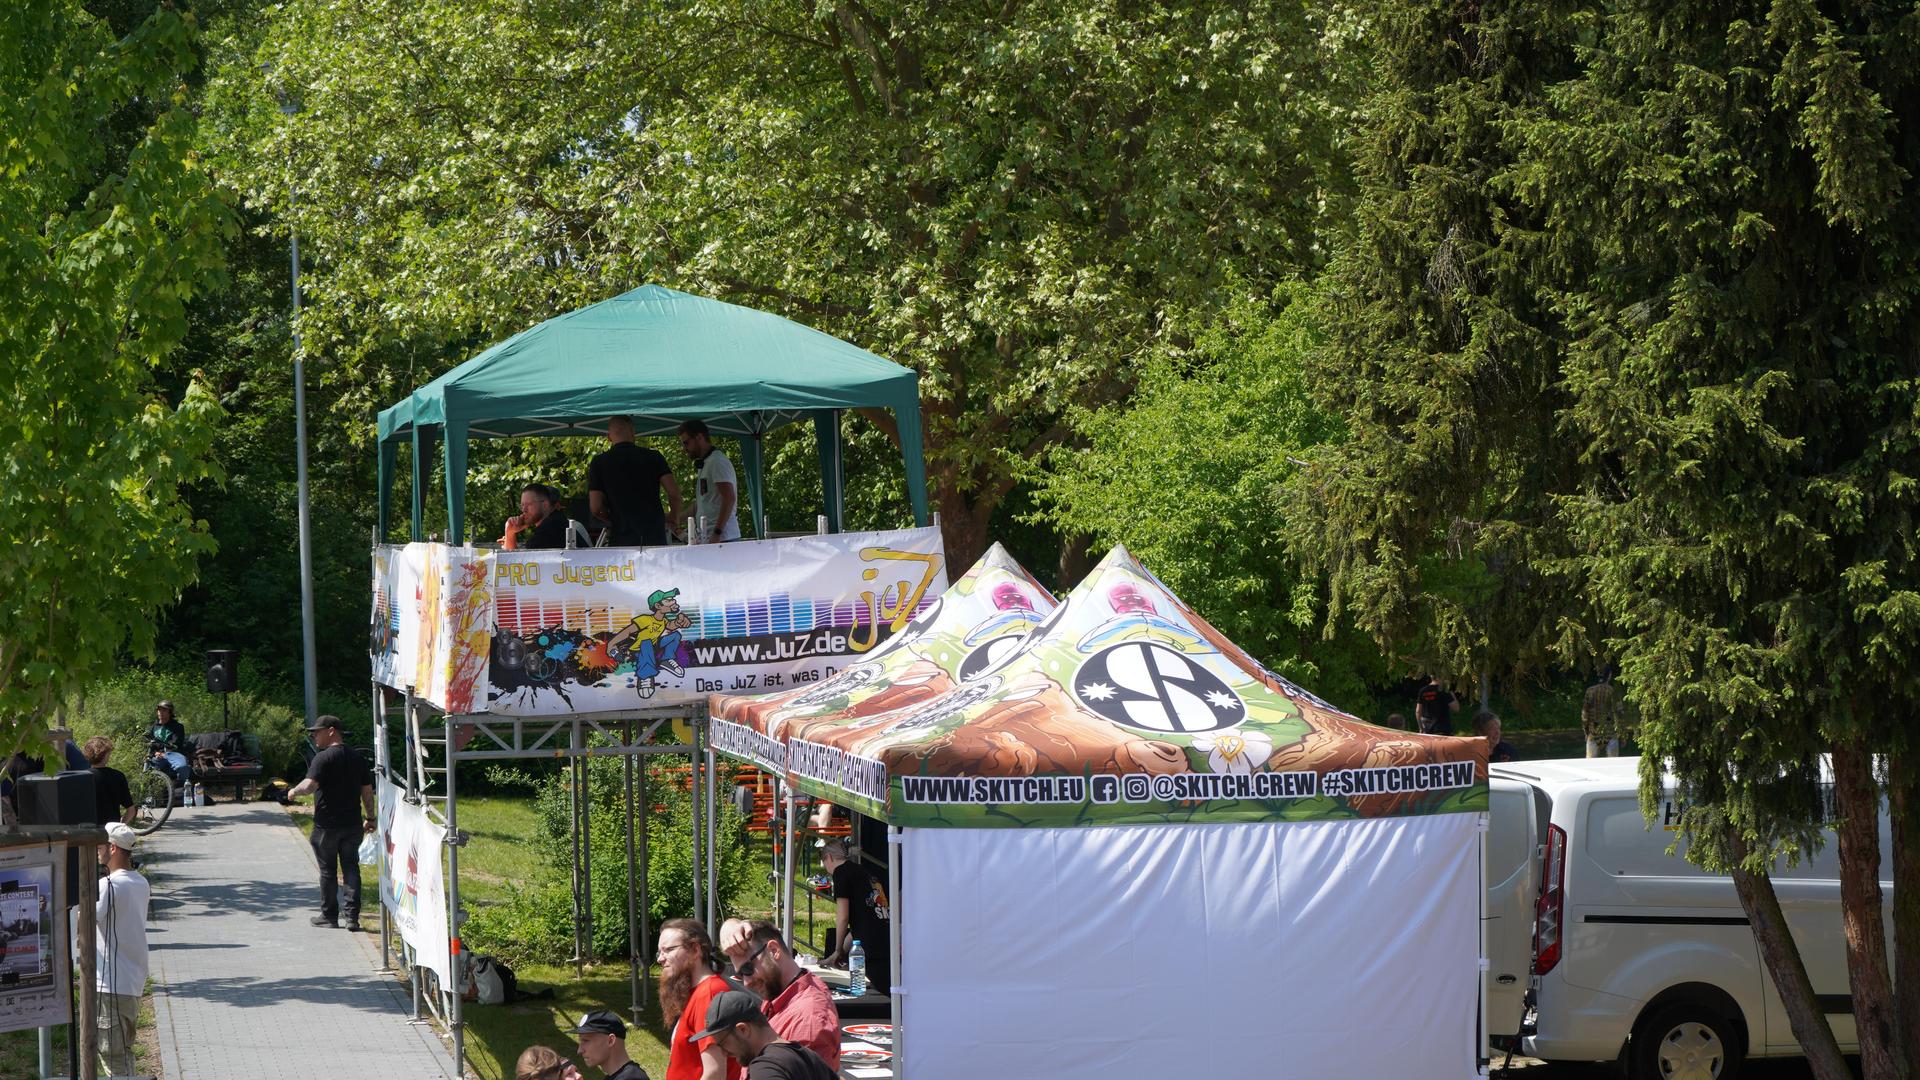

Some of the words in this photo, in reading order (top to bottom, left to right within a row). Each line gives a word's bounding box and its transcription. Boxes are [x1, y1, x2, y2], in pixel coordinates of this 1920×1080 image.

[495, 562, 541, 587] PRO
[553, 560, 636, 586] Jugend
[695, 631, 846, 664] www.JuZ.de
[696, 678, 723, 692] Das
[730, 675, 756, 688] JuZ
[764, 673, 784, 687] ist,
[792, 669, 819, 682] was
[904, 777, 1083, 802] WWW.SKITCH.EU
[1153, 773, 1316, 800] @SKITCH.CREW
[1324, 763, 1473, 795] #SKITCHCREW
